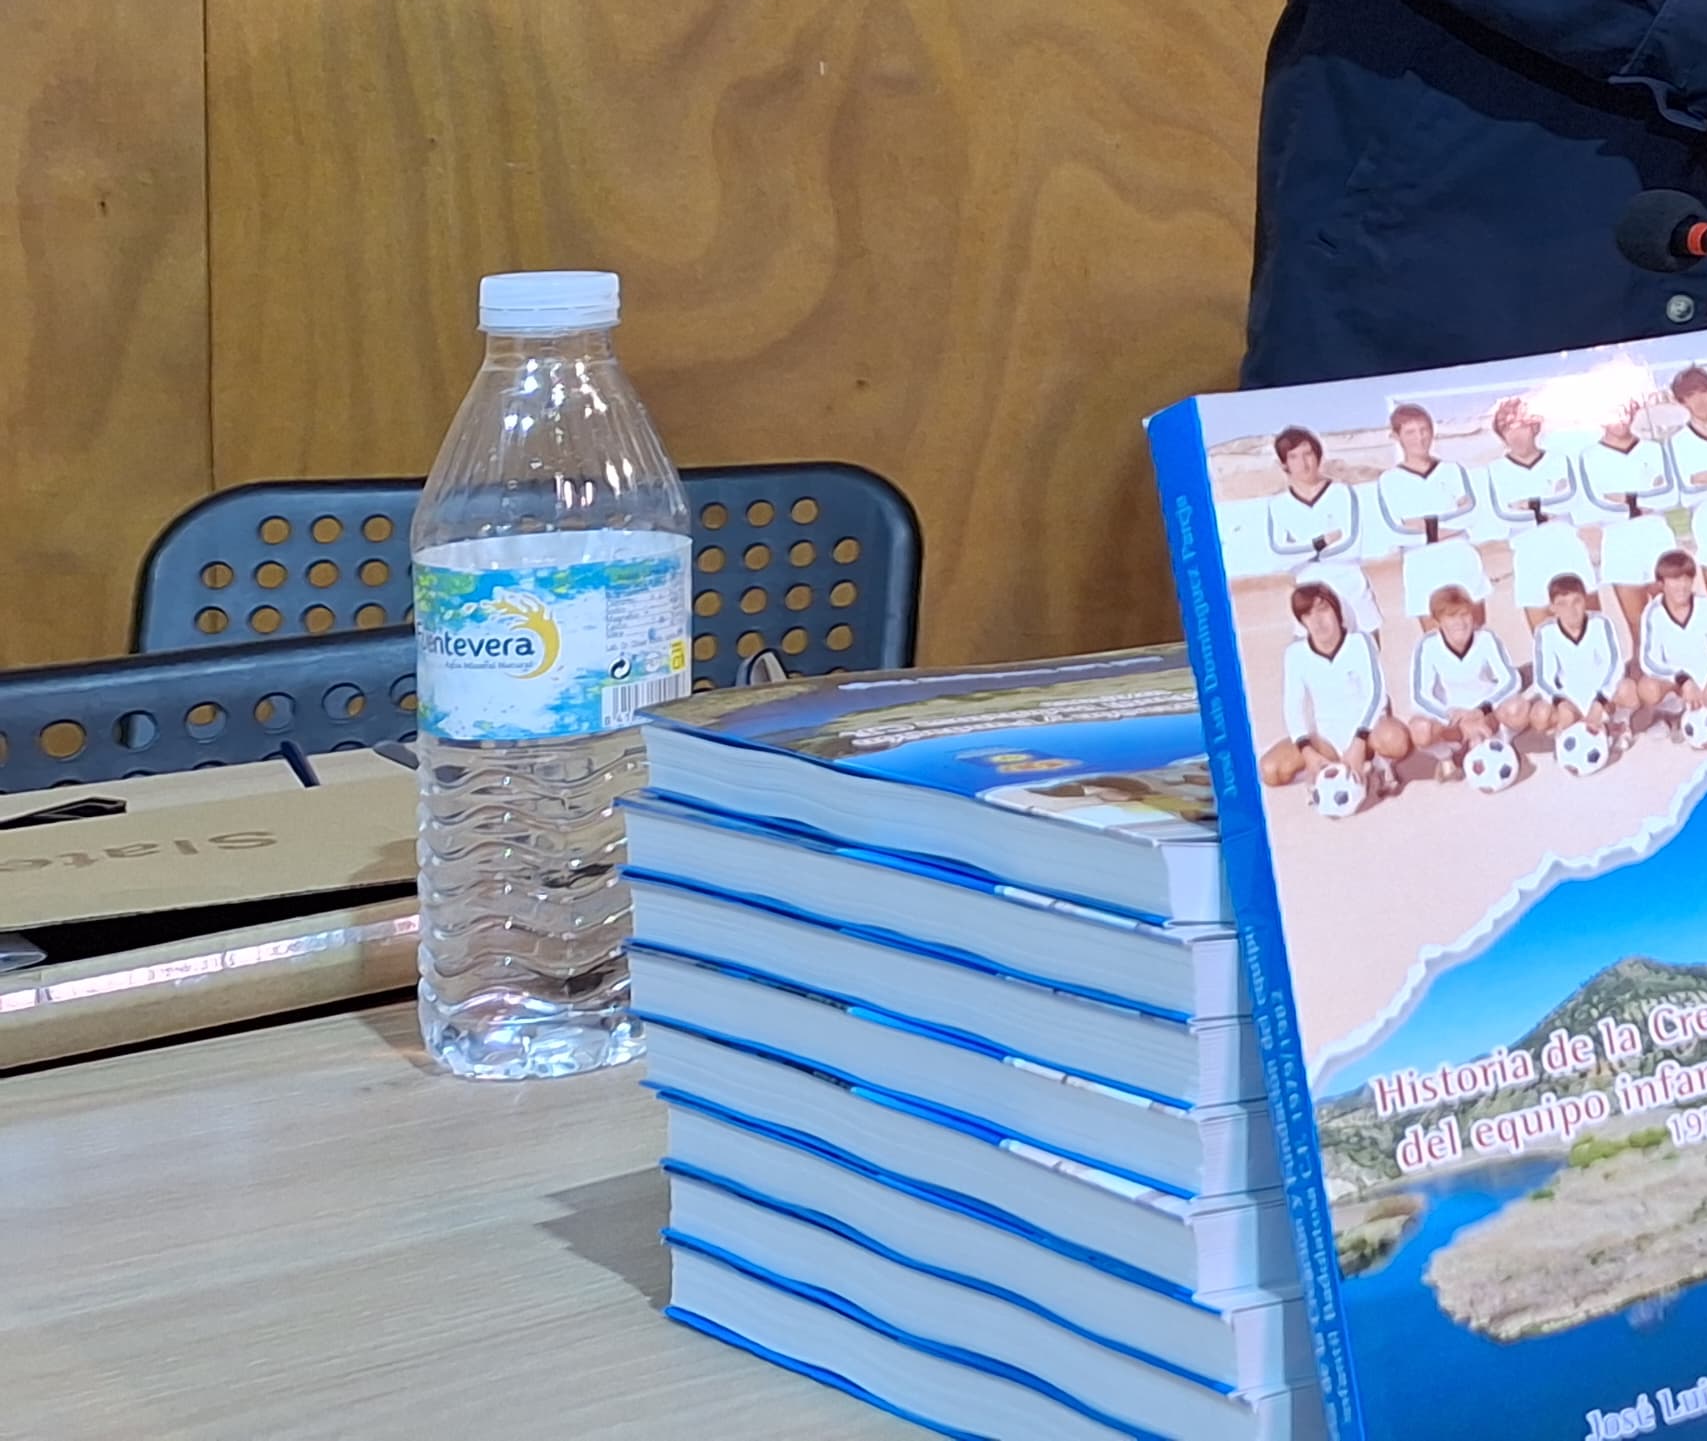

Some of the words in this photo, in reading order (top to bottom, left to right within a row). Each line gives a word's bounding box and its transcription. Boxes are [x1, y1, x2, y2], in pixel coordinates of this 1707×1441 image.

[1374, 1048, 1534, 1114] Historia
[1544, 1032, 1594, 1071] de
[1601, 1019, 1640, 1058] la
[1400, 1120, 1460, 1170] del
[1473, 1091, 1606, 1152] equipo
[1586, 1394, 1656, 1441] José
